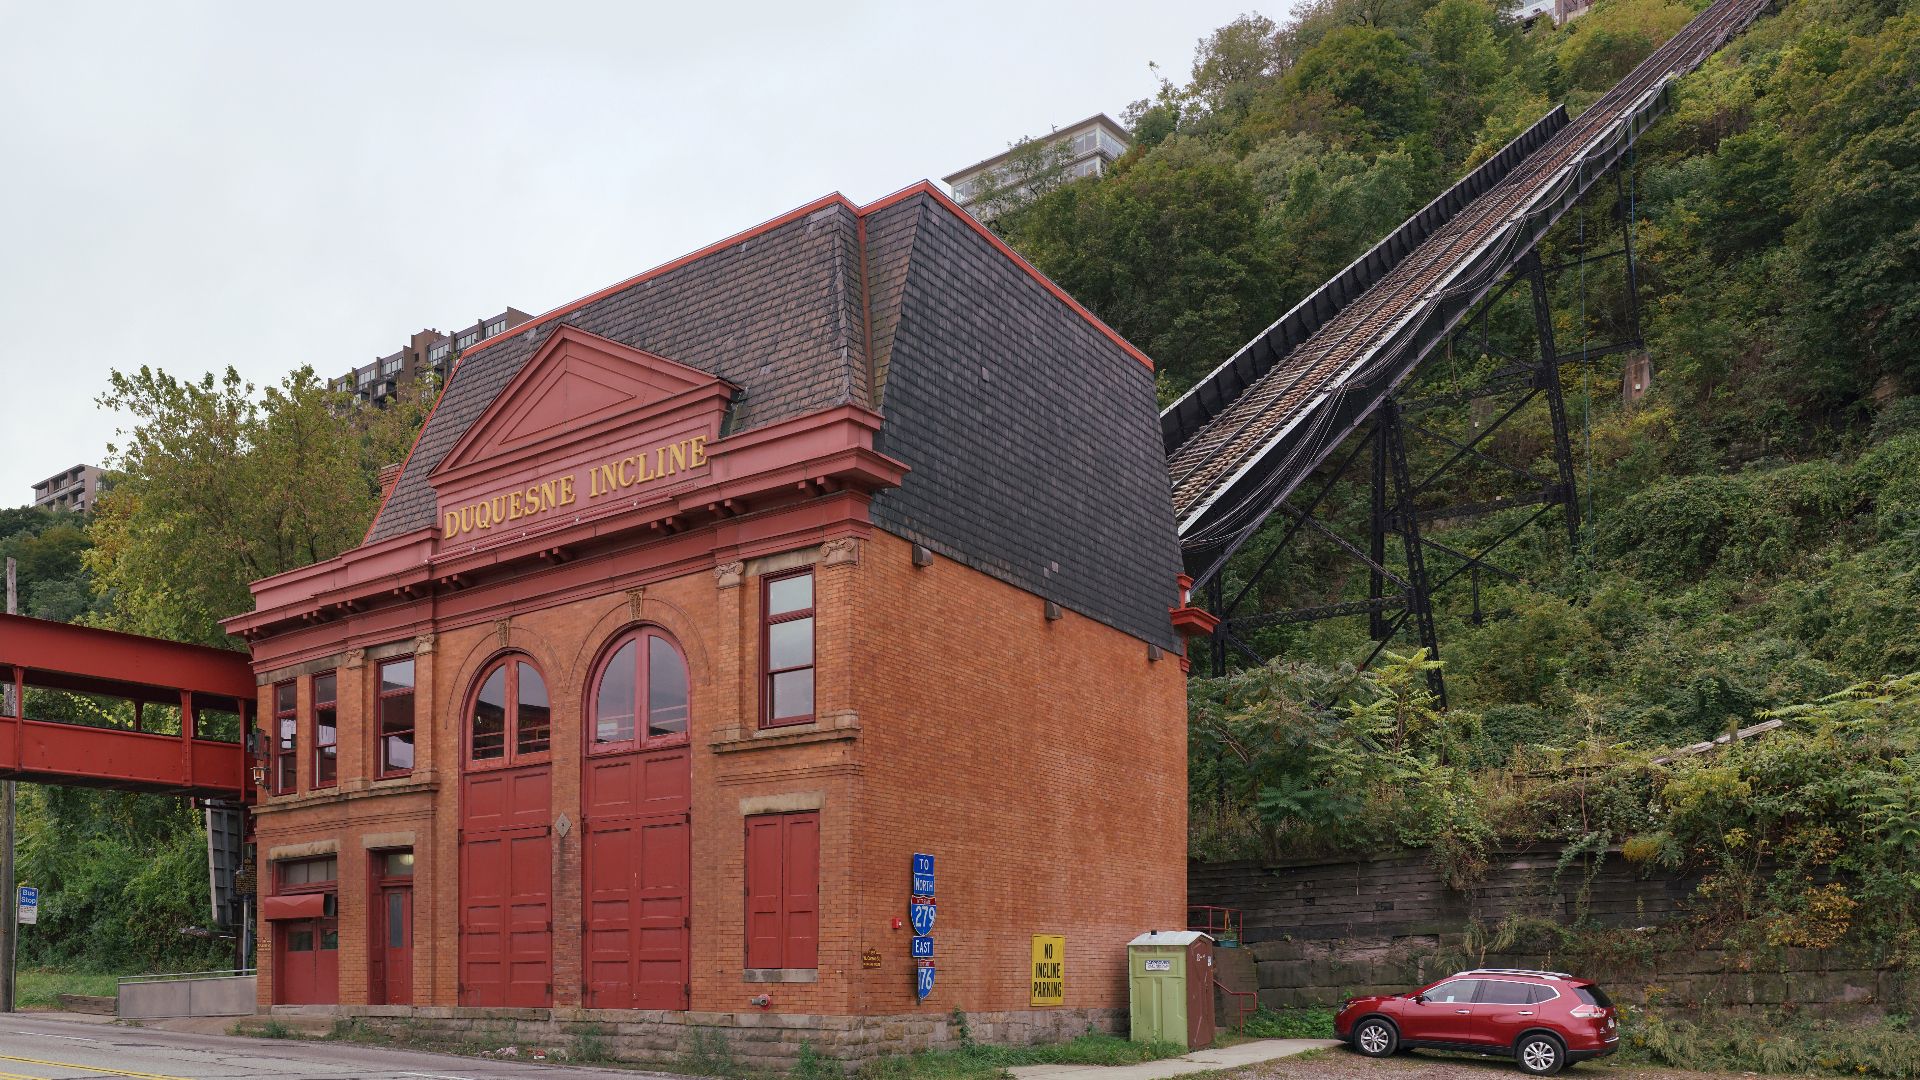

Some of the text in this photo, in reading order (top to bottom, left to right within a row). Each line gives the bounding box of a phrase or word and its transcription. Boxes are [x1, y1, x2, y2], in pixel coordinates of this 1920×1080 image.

[444, 434, 710, 540] DUQUESNE INCLINE
[919, 858, 929, 870] TO
[915, 877, 934, 892] NORTH
[21, 896, 36, 905] Stop
[915, 905, 935, 928] 279
[915, 939, 931, 954] EAST
[1044, 943, 1053, 960] NO
[1035, 962, 1061, 979] INCLINE
[1033, 981, 1062, 998] PARKING
